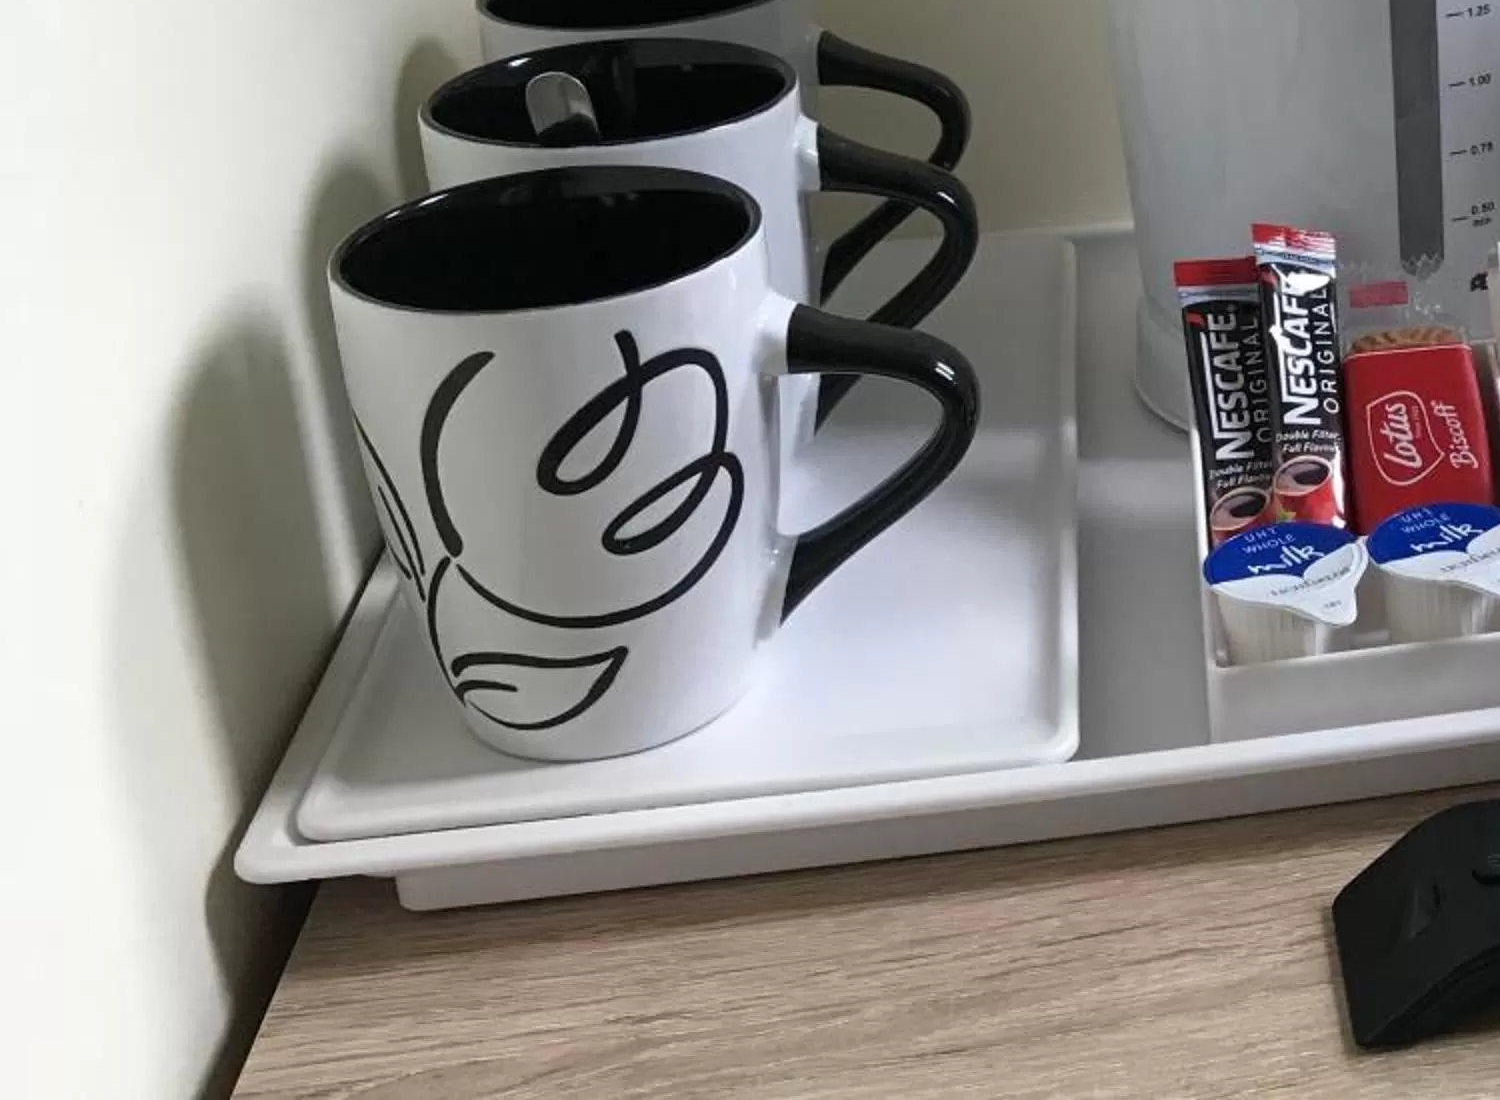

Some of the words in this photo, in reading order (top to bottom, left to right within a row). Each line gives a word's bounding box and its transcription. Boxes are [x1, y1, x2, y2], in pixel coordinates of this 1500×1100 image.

[1466, 3, 1491, 18] 1.25
[1469, 73, 1492, 88] 1.00
[1310, 289, 1341, 416] ORIGINAL
[1243, 315, 1273, 444] ORIGINAL
[1379, 402, 1423, 470] Lotus
[1431, 400, 1479, 469] Biscoff
[1401, 507, 1432, 523] UHT
[1402, 513, 1450, 535] WHOLE
[1242, 533, 1296, 555] WHOLE
[1244, 527, 1278, 543] UHT
[1410, 521, 1485, 552] milk
[1248, 543, 1325, 574] milk
